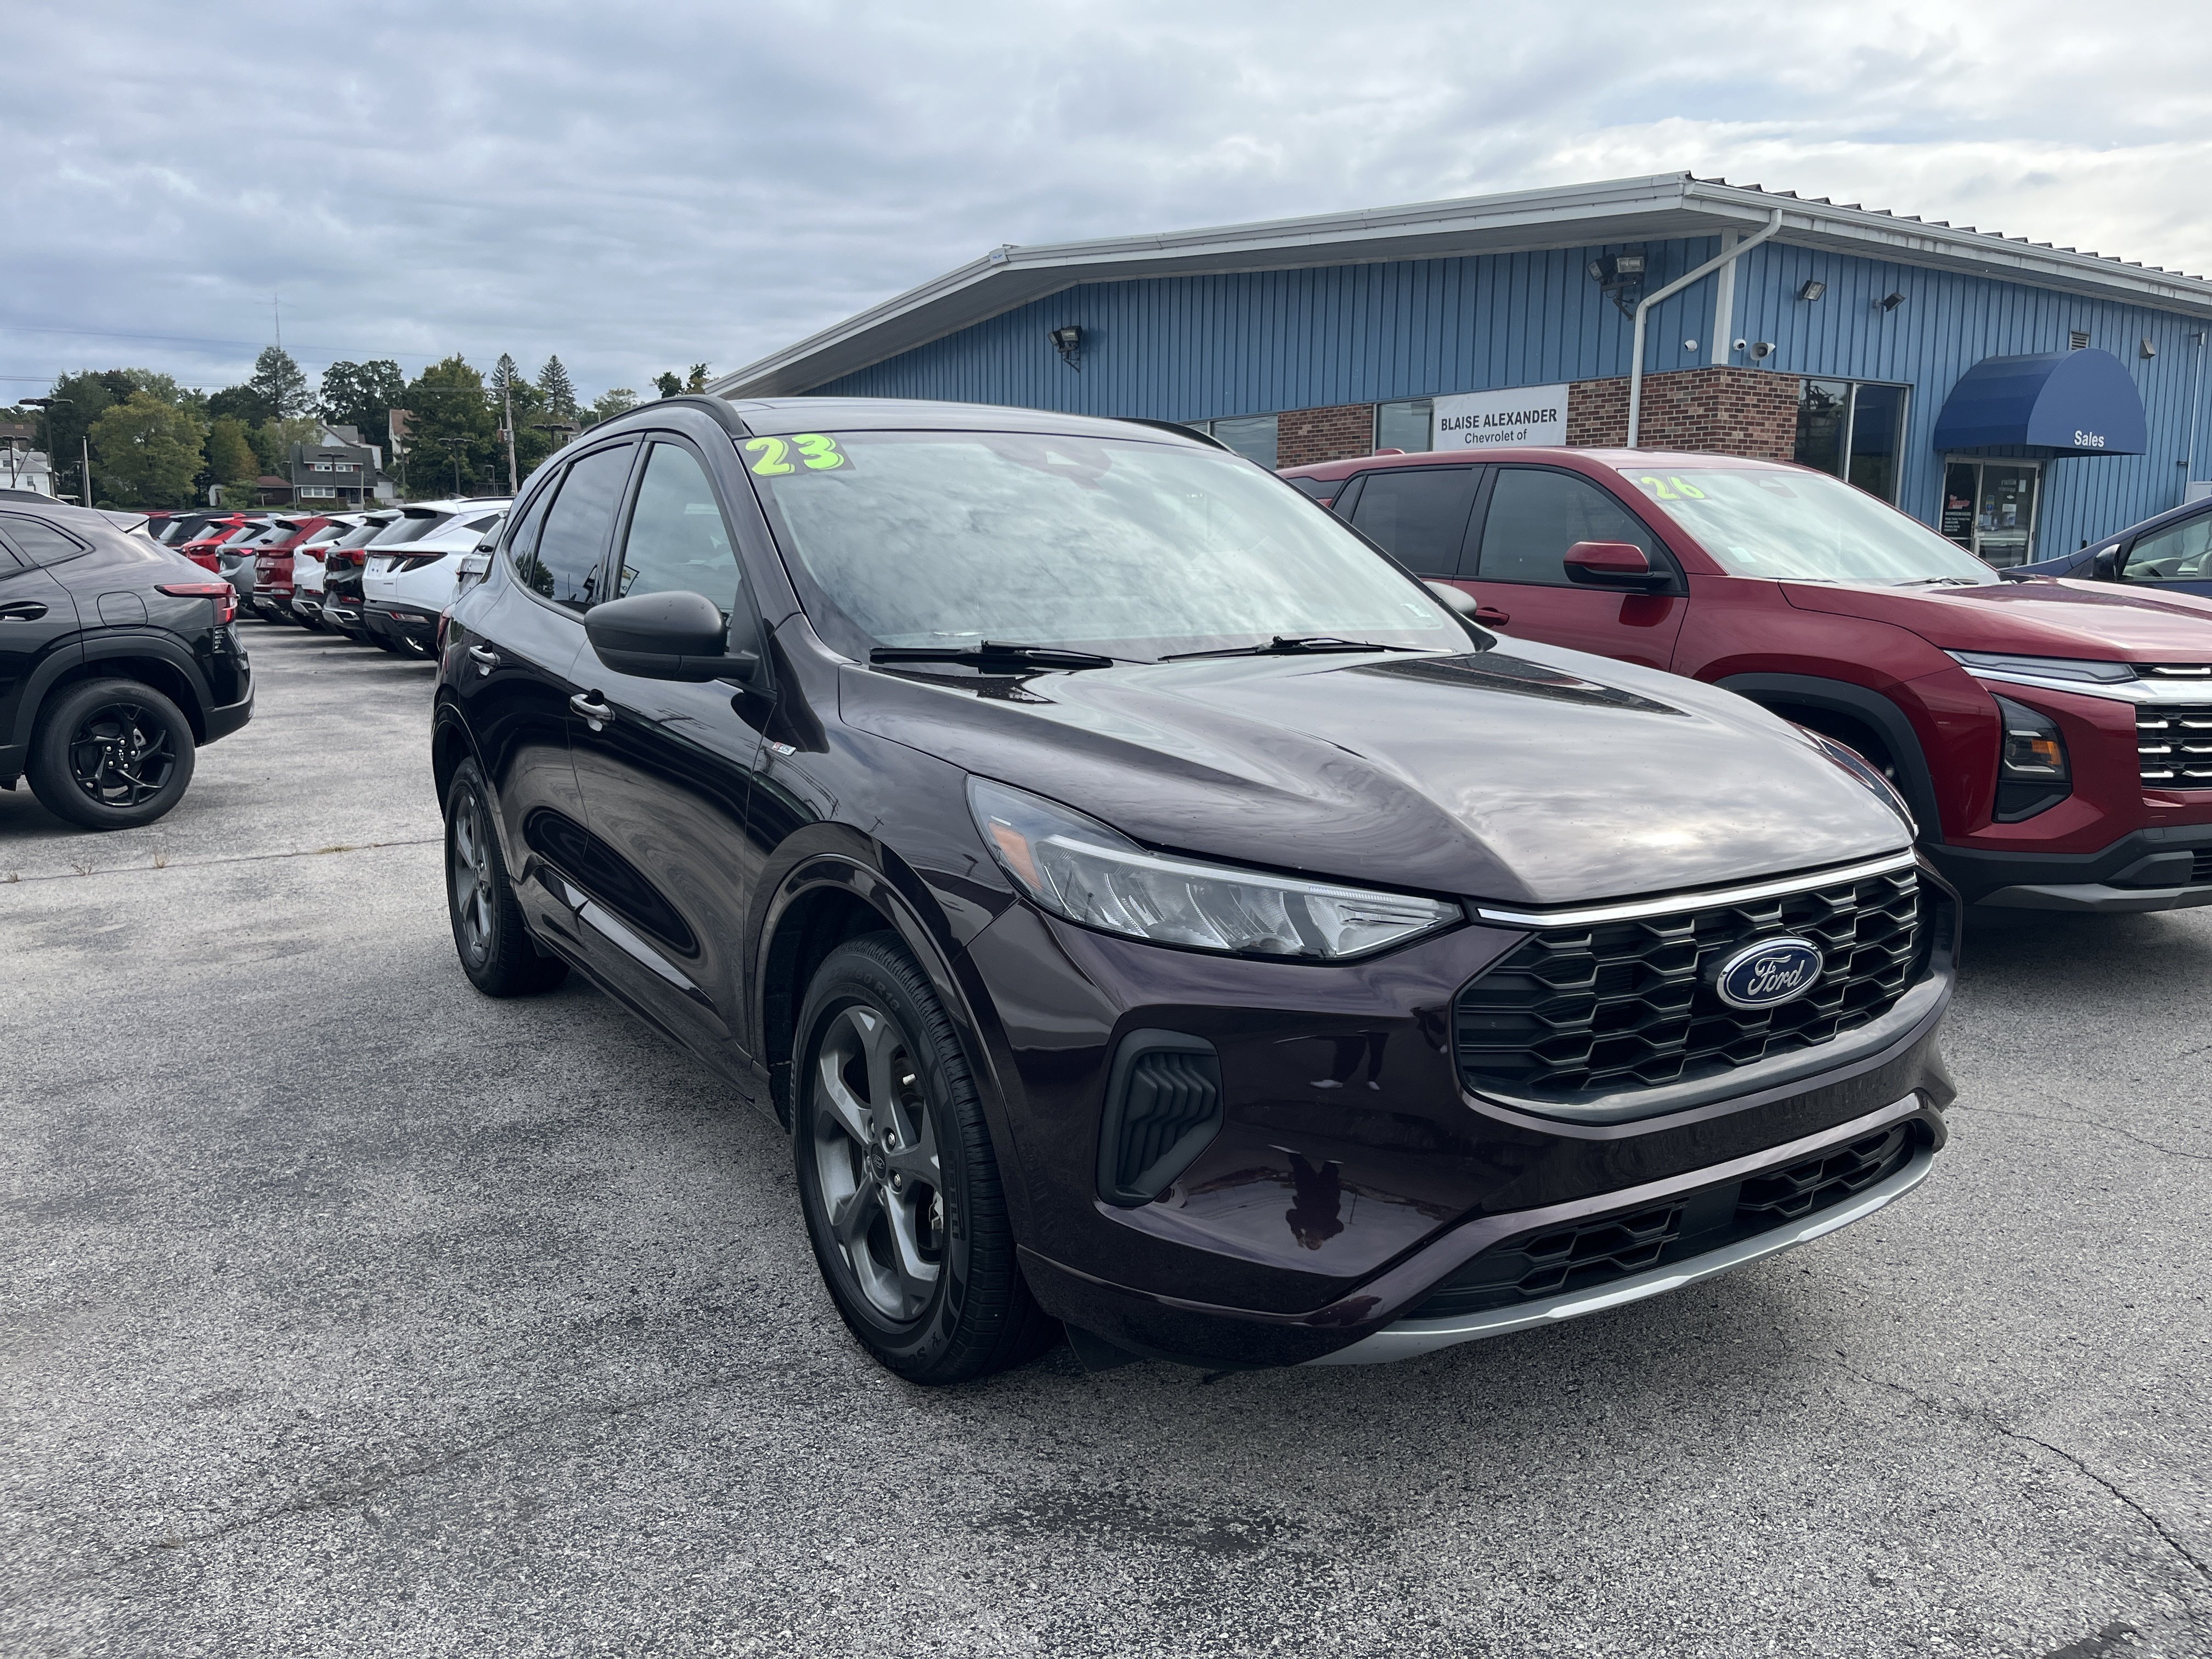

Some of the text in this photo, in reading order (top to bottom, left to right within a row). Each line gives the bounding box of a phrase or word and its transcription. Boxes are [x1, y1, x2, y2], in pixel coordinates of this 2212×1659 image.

[1441, 409, 1557, 431] BLAISE ALEXANDER
[1465, 429, 1527, 444] Chevrolet of
[2074, 430, 2104, 448] Sales
[745, 433, 845, 476] 23
[1641, 476, 1705, 500] 26
[1747, 955, 1805, 996] Ford
